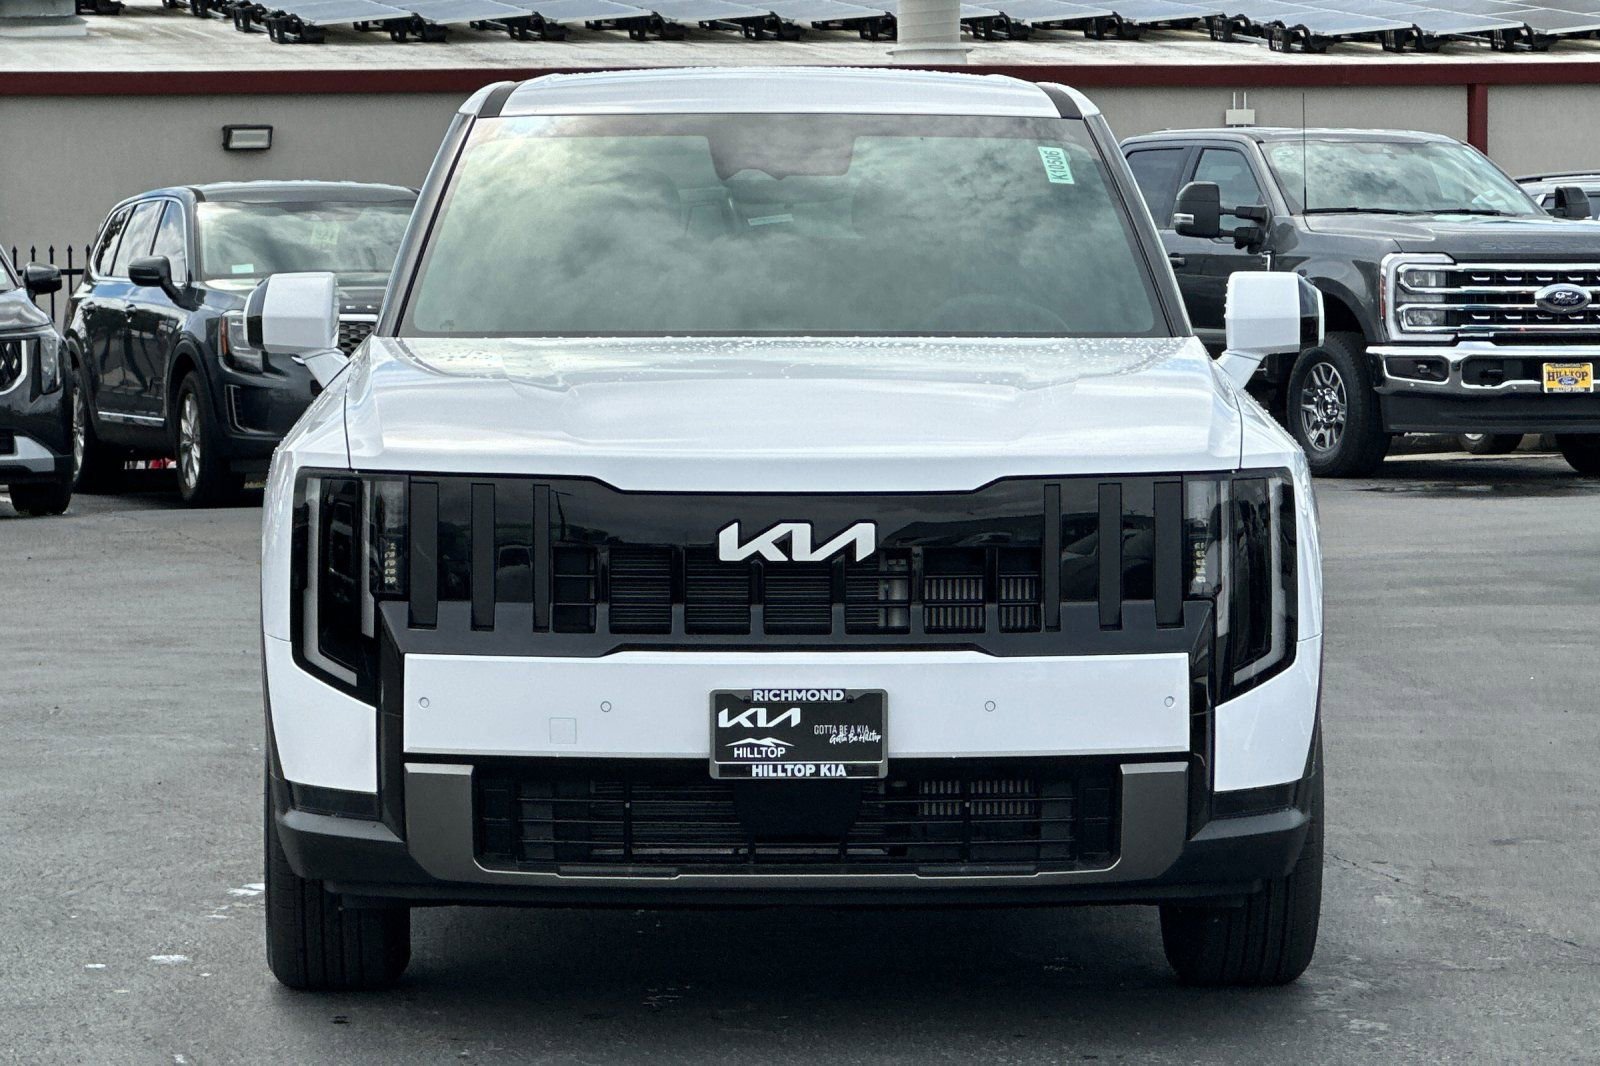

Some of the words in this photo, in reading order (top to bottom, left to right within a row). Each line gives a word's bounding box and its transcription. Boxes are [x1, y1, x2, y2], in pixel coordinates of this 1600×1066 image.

[1044, 150, 1070, 181] K10506
[1553, 291, 1579, 304] Ford
[1547, 370, 1588, 381] HILLTOP
[719, 522, 875, 562] KIA
[753, 689, 845, 701] RICHMOND
[718, 707, 800, 728] KIA
[813, 724, 837, 735] GOTTA
[839, 724, 848, 735] BE
[850, 724, 855, 734] A
[857, 724, 869, 734] KIA
[829, 732, 847, 745] Gotta
[848, 732, 859, 743] Be
[734, 746, 785, 758] HILLTOP
[752, 764, 816, 777] HILLTOP
[820, 764, 846, 777] KIA
